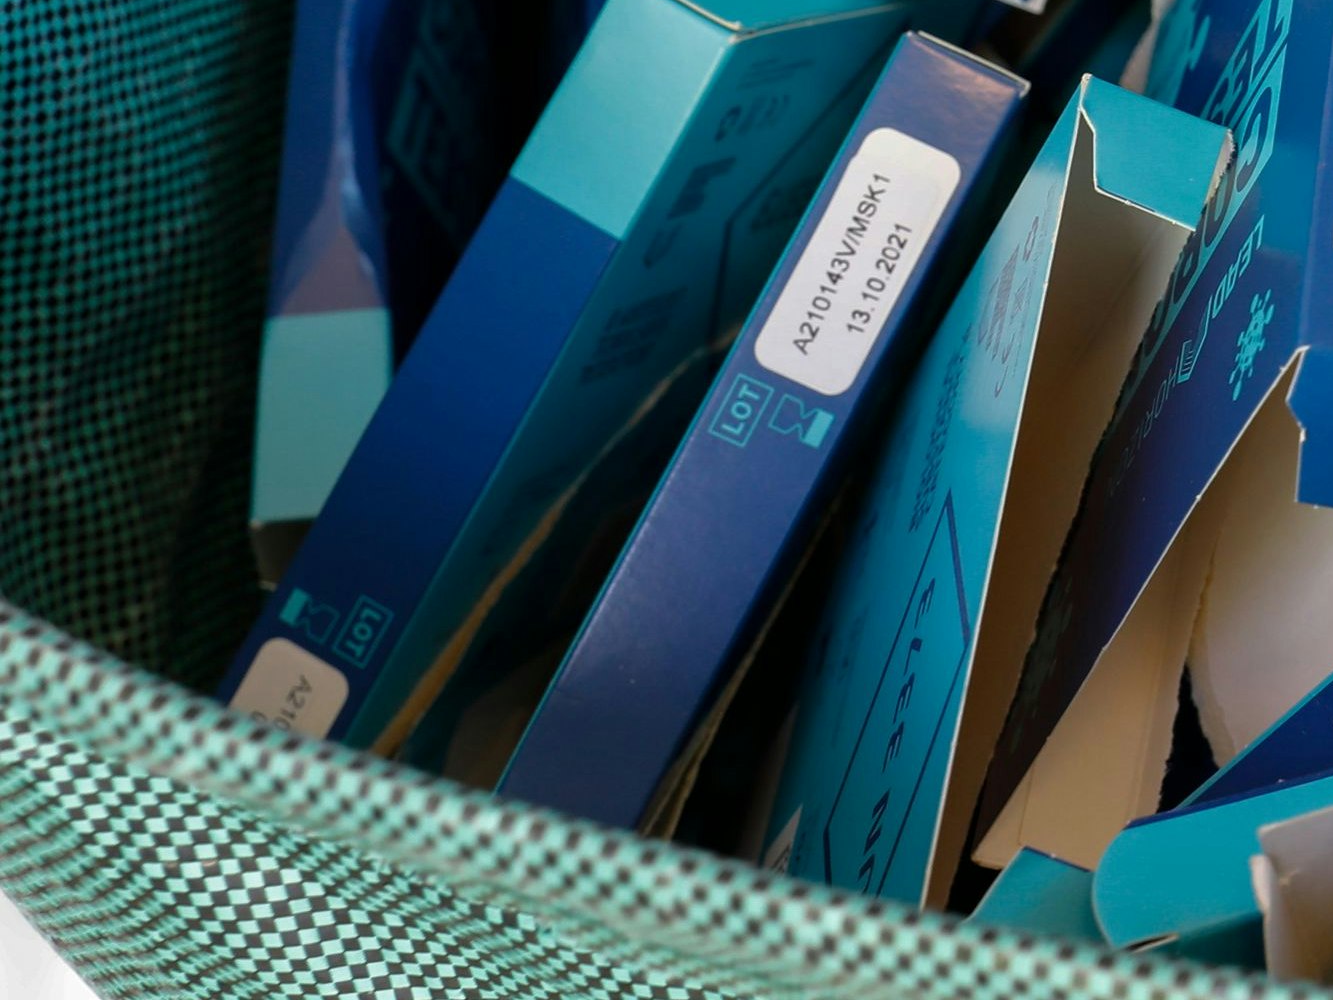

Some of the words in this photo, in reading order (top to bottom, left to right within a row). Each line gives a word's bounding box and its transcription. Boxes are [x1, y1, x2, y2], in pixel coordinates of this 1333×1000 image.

[792, 172, 892, 357] A210143V/MSK1
[847, 222, 914, 335] 13.10.2021
[1211, 214, 1266, 321] LEAD
[721, 383, 761, 437] LOT
[344, 607, 383, 658] LOT
